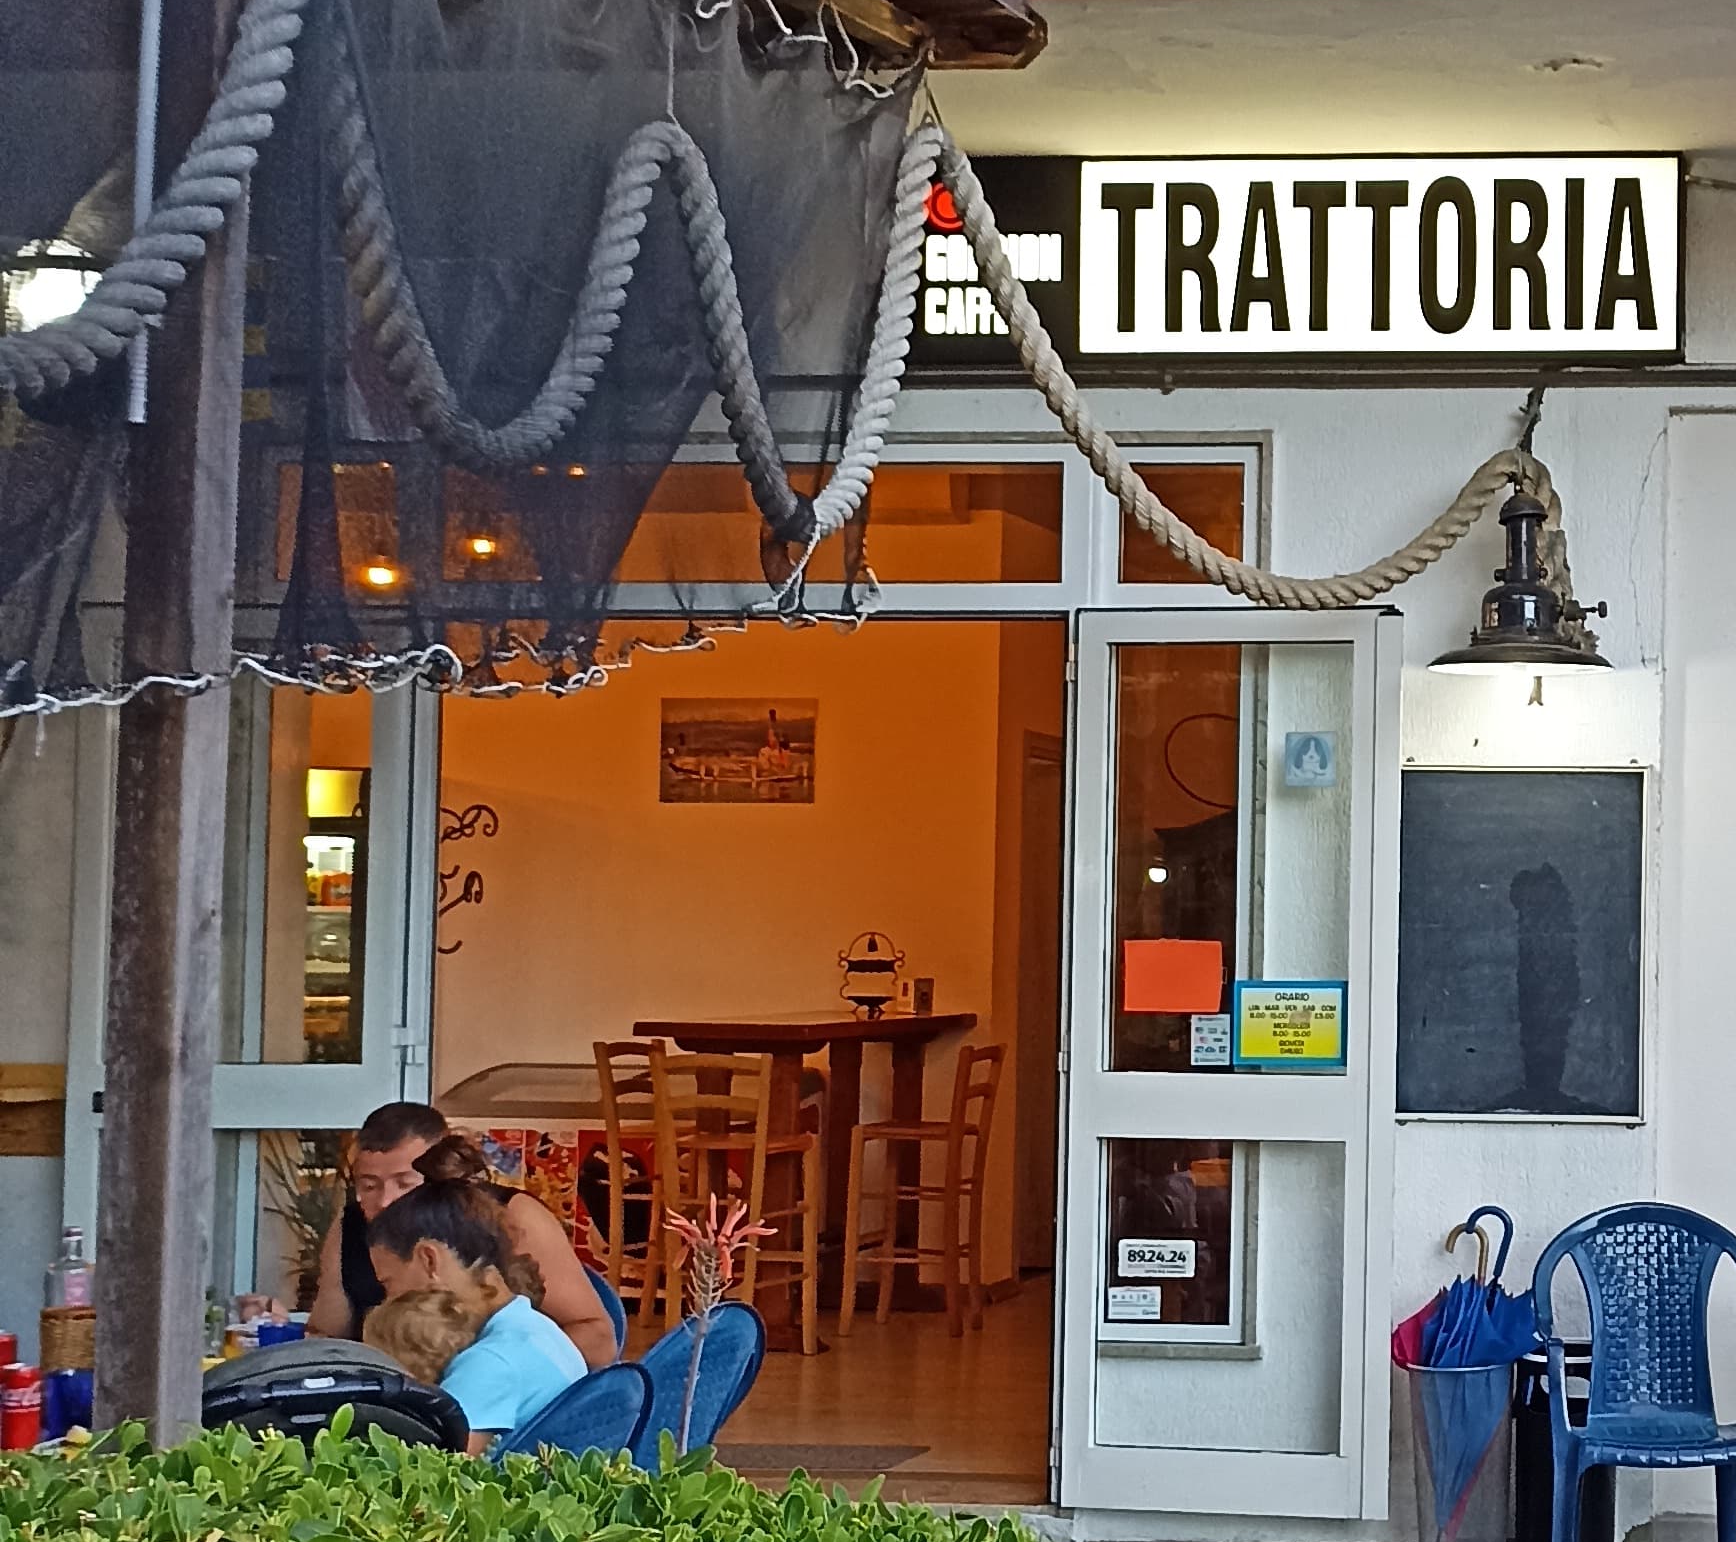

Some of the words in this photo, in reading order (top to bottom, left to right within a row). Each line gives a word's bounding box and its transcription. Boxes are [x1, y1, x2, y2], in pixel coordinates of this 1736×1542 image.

[925, 233, 1062, 282] GOION
[1100, 176, 1659, 334] TRATTORIA
[1274, 992, 1310, 1001] ORARIO
